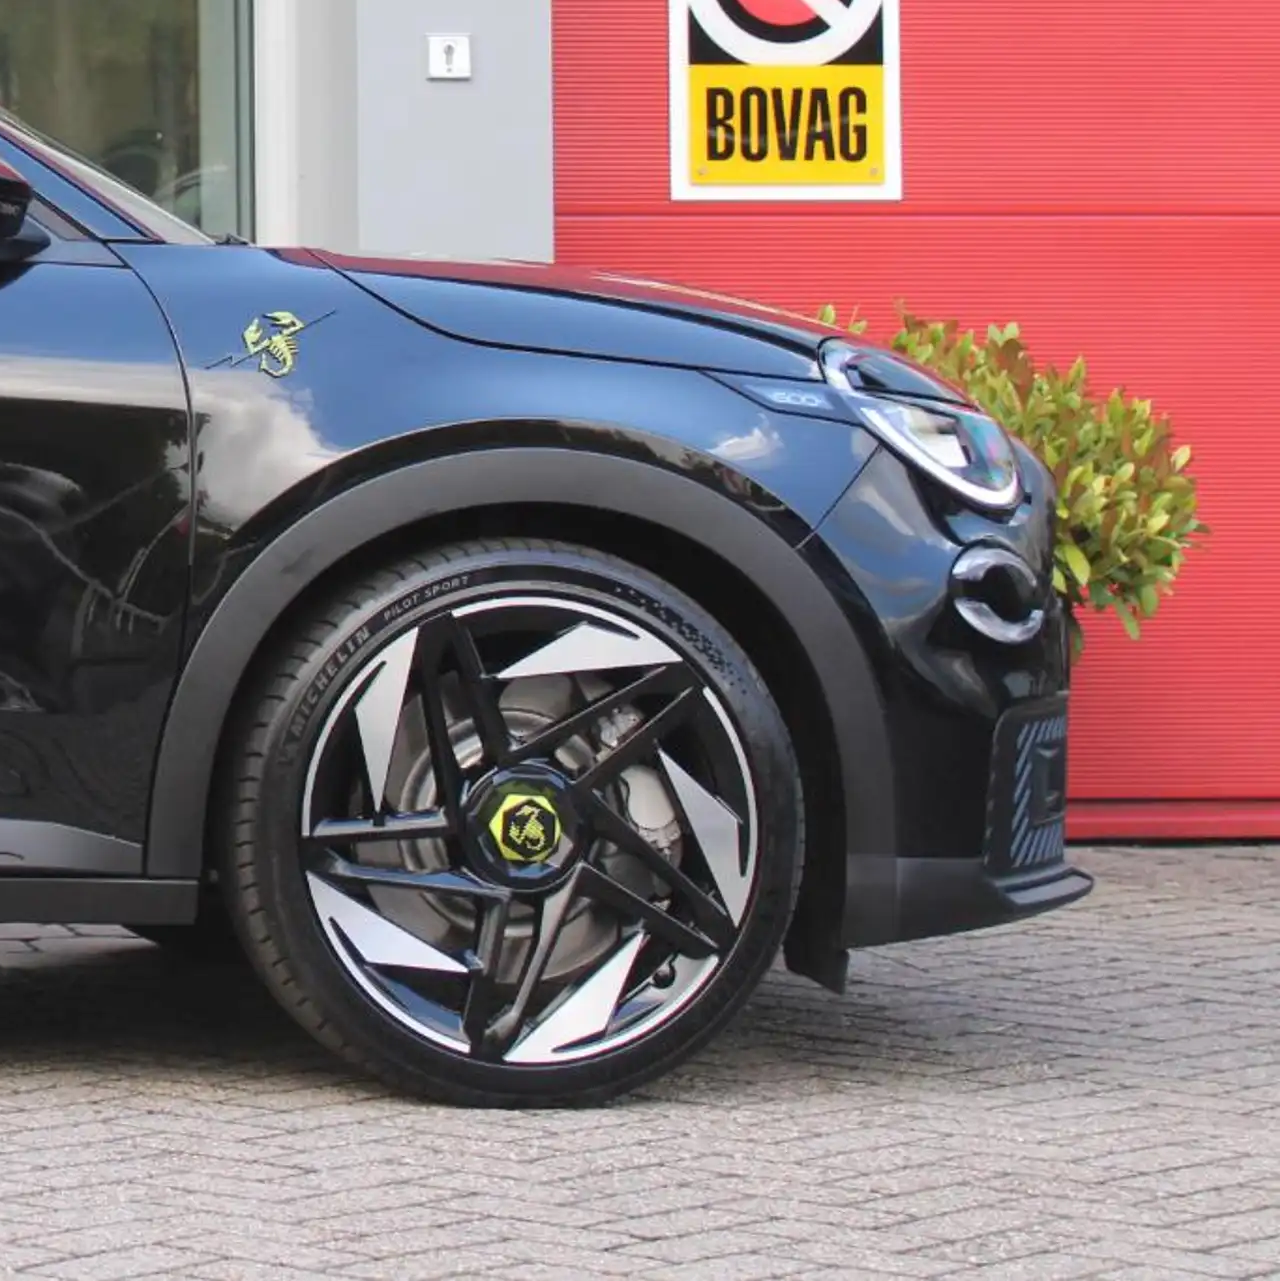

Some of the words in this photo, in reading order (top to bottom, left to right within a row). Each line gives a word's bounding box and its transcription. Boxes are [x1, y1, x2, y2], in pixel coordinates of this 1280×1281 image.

[705, 85, 868, 163] BOVAG
[290, 626, 372, 737] MICHELIN
[383, 592, 420, 620] PILOT
[424, 575, 469, 600] SPORT
